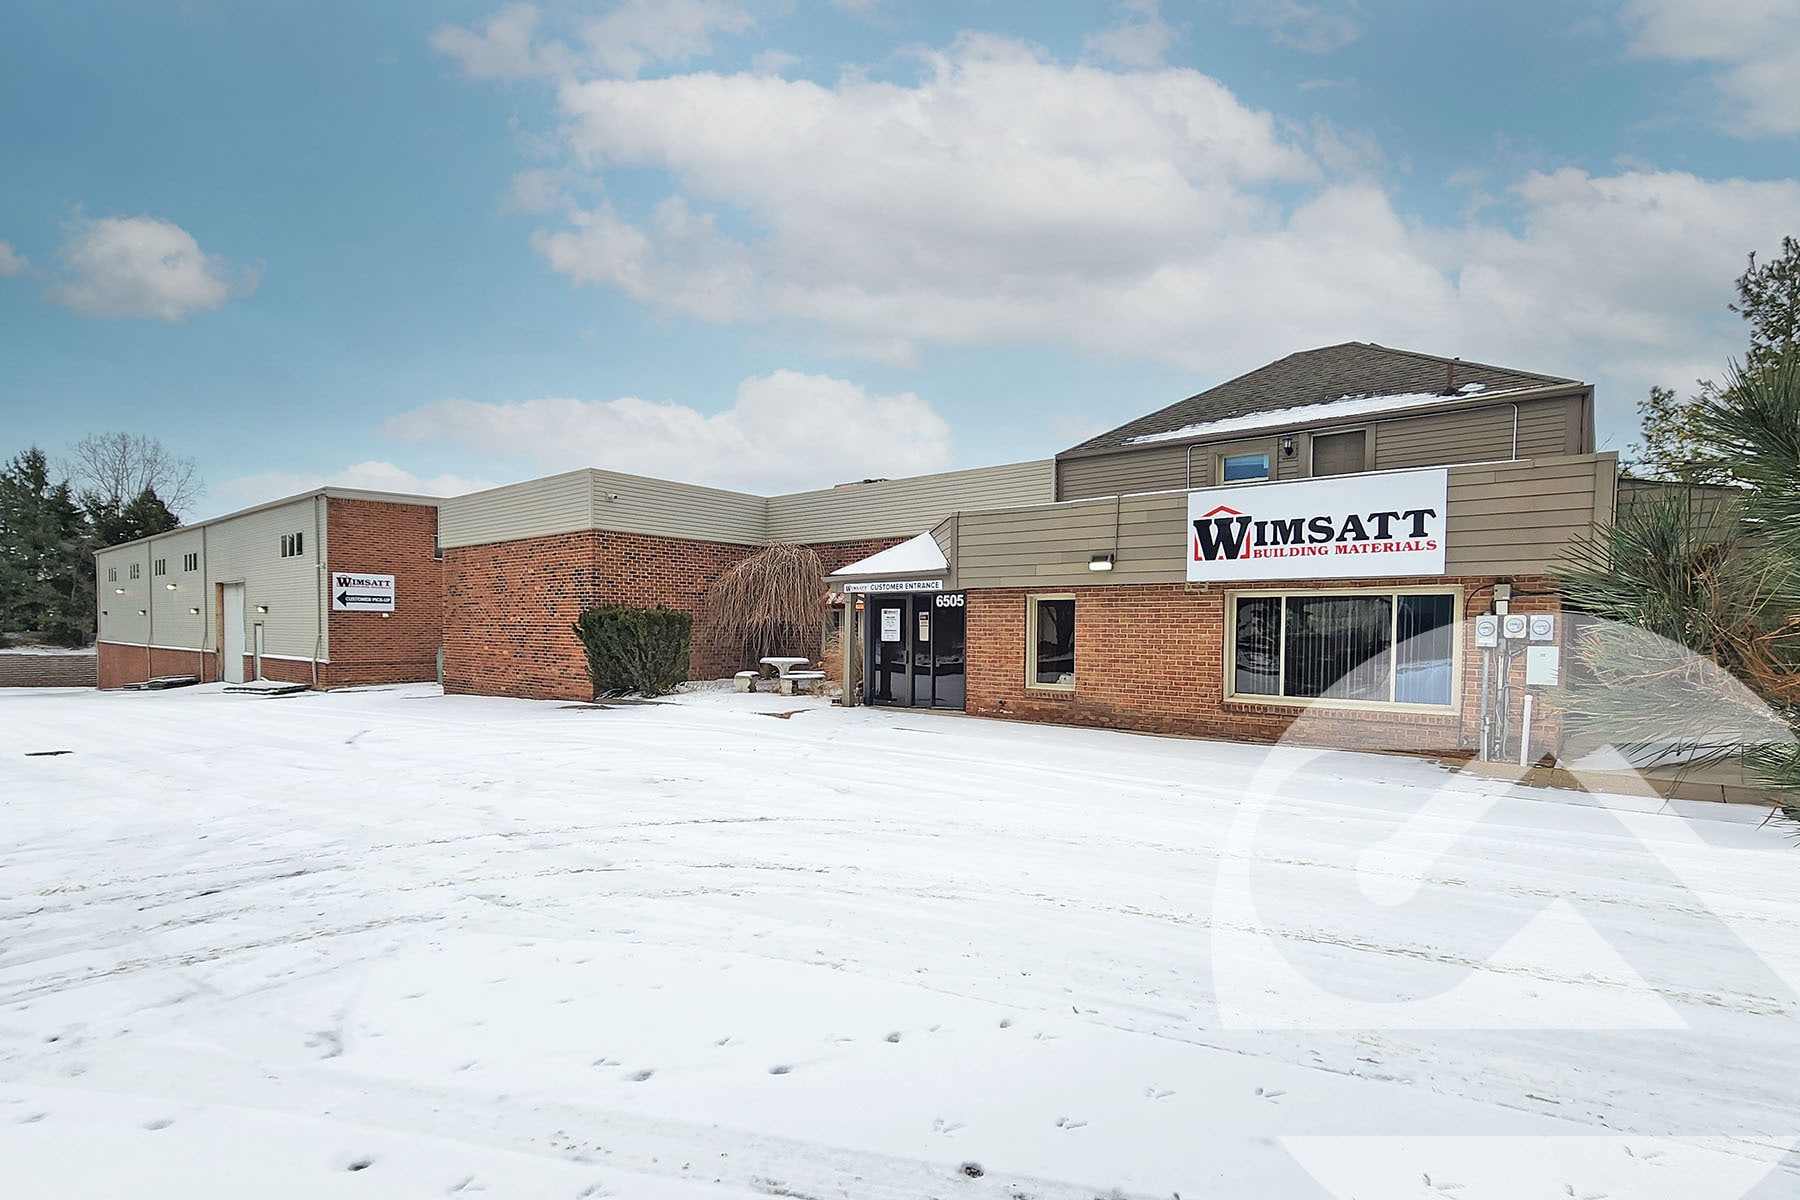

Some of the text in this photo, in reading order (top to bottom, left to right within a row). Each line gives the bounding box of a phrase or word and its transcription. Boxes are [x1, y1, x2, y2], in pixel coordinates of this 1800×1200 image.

[1193, 508, 1437, 560] WIMSATT
[1253, 540, 1438, 559] BUILDING MATERIALS
[336, 576, 391, 587] WIMSATT
[870, 581, 939, 591] CUSTOMER ENTRANCE
[936, 594, 964, 607] 6505
